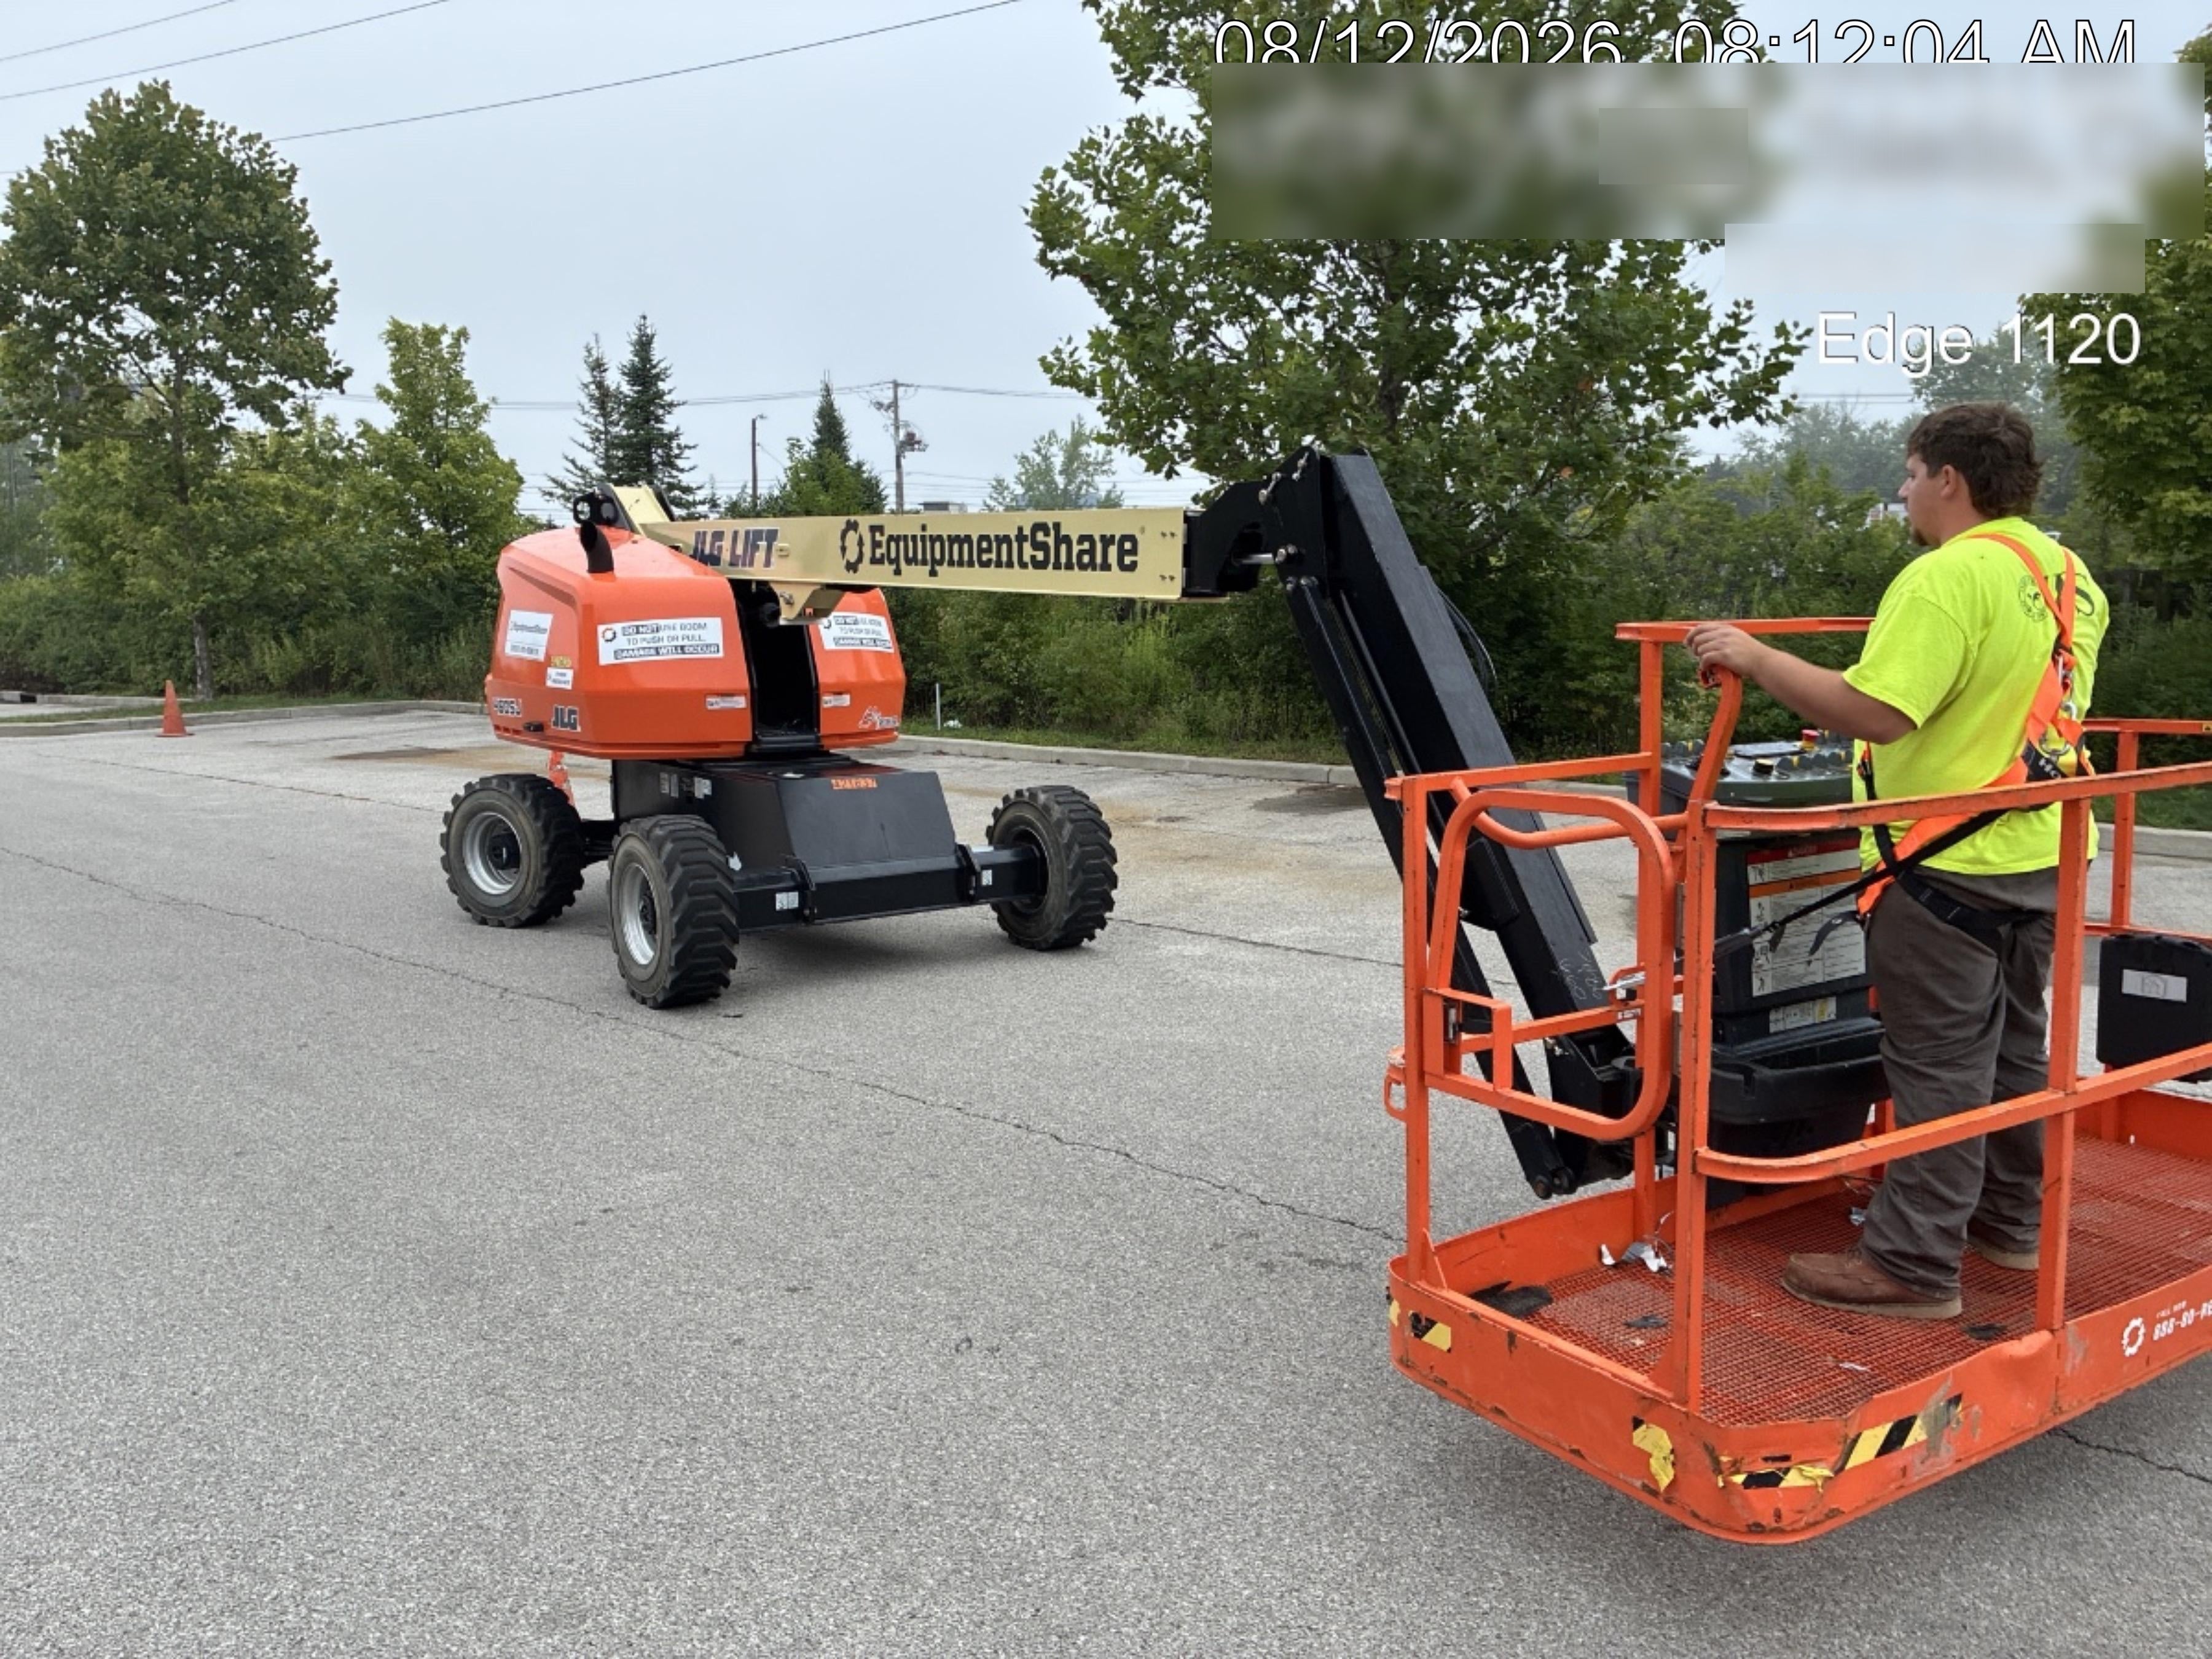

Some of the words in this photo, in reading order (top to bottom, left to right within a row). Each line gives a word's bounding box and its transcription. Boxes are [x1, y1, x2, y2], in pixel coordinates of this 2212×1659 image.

[728, 527, 779, 568] LIFT
[869, 522, 1139, 577] EquipmentShare
[639, 625, 659, 634] NOT
[659, 624, 677, 632] USE
[680, 622, 707, 632] BOOM
[627, 637, 638, 646] TO
[641, 635, 664, 645] PUSH
[667, 635, 679, 643] OR
[658, 646, 683, 656] WILL
[552, 705, 580, 732] JLG
